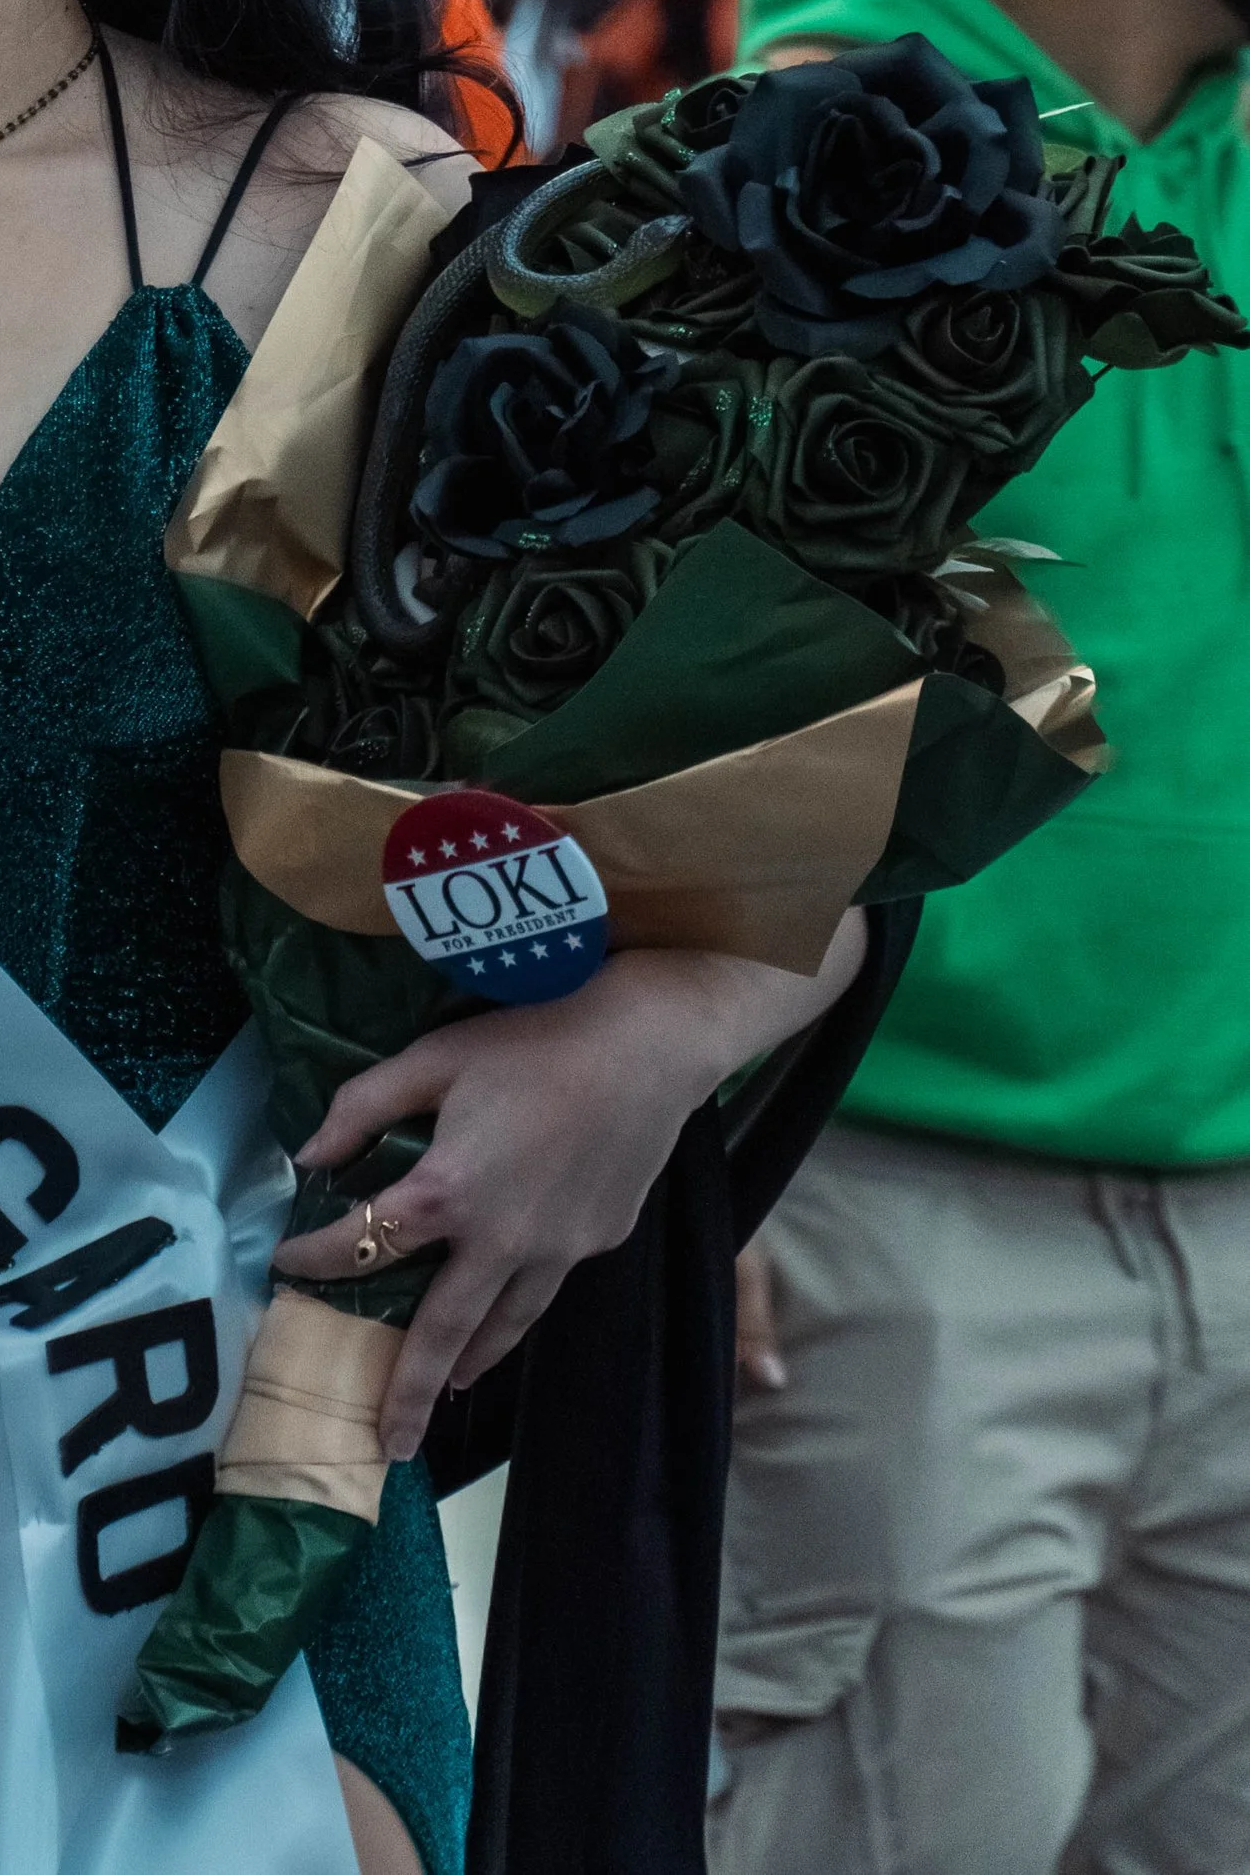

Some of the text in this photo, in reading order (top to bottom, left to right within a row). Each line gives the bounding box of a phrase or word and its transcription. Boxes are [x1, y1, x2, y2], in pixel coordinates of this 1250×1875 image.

[397, 844, 588, 942] LOKI
[442, 908, 578, 953] FOR PRESIDENT
